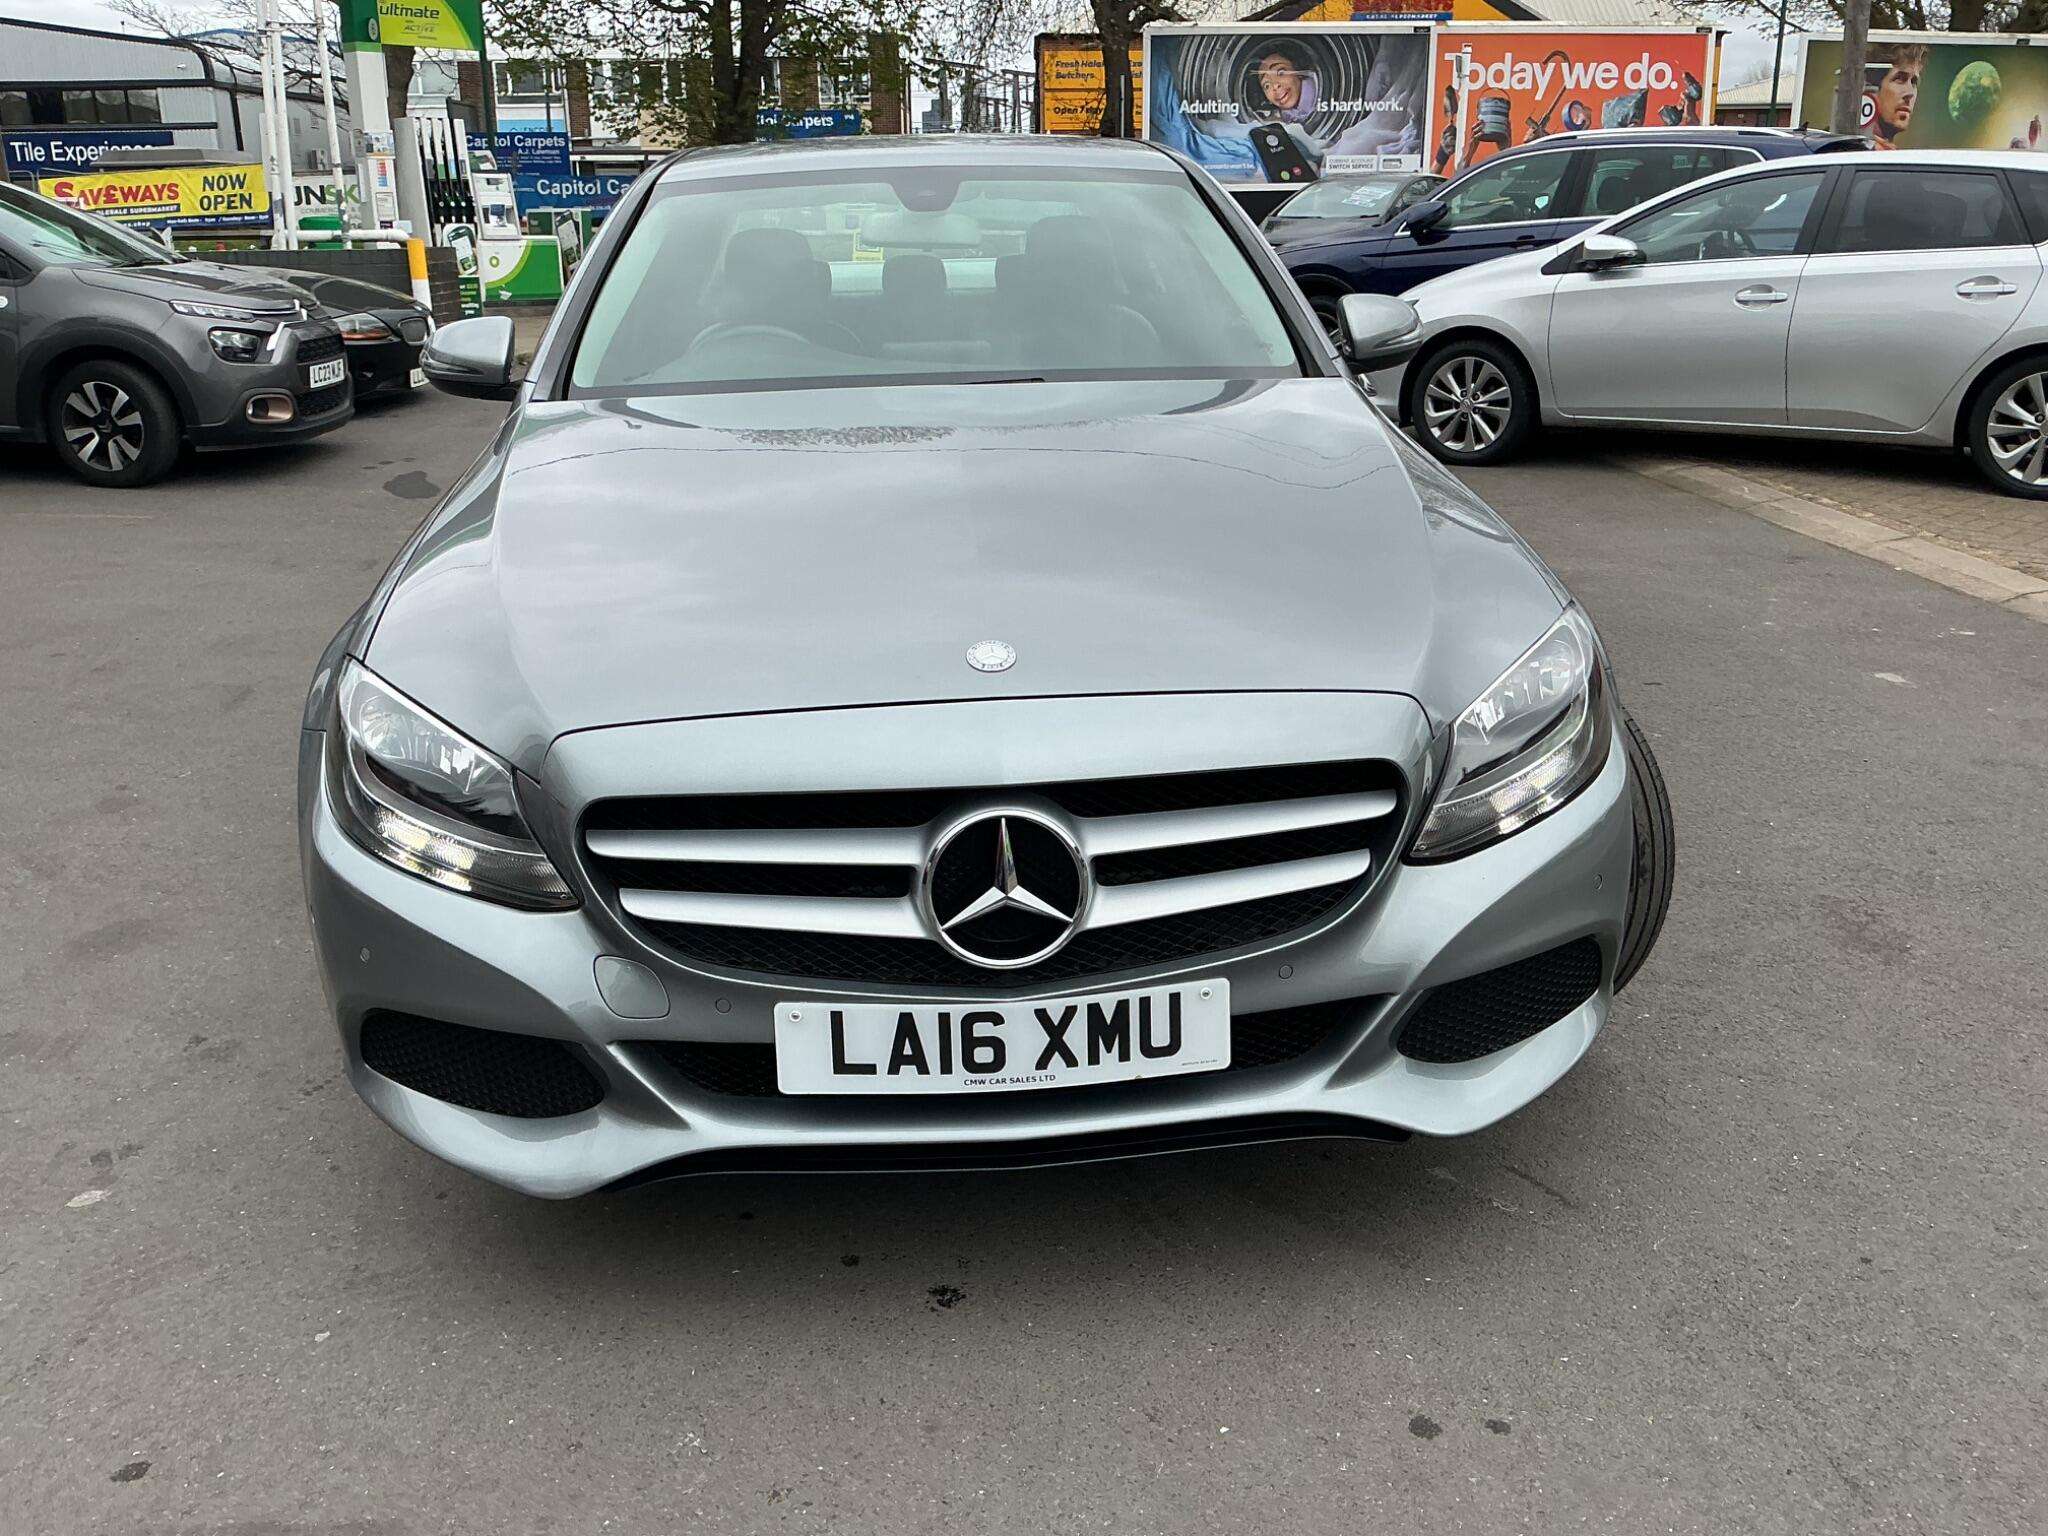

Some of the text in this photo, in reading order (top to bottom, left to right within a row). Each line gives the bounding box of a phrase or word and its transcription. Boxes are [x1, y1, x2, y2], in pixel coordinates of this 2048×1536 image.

[379, 3, 440, 19] ultimate
[1055, 60, 1079, 68] Fresh
[1444, 52, 1678, 101] Today we do.
[1053, 106, 1078, 115] Open
[1179, 97, 1404, 117] Adulting is hard work.
[465, 134, 566, 150] Captol Carpets
[10, 142, 46, 162] Tile
[202, 173, 248, 192] NOW
[536, 179, 602, 199] Capitol
[199, 192, 254, 211] OPEN
[829, 991, 1182, 1076] LA16 XMU
[963, 1074, 1056, 1086] CMW CAR SALES LTD
